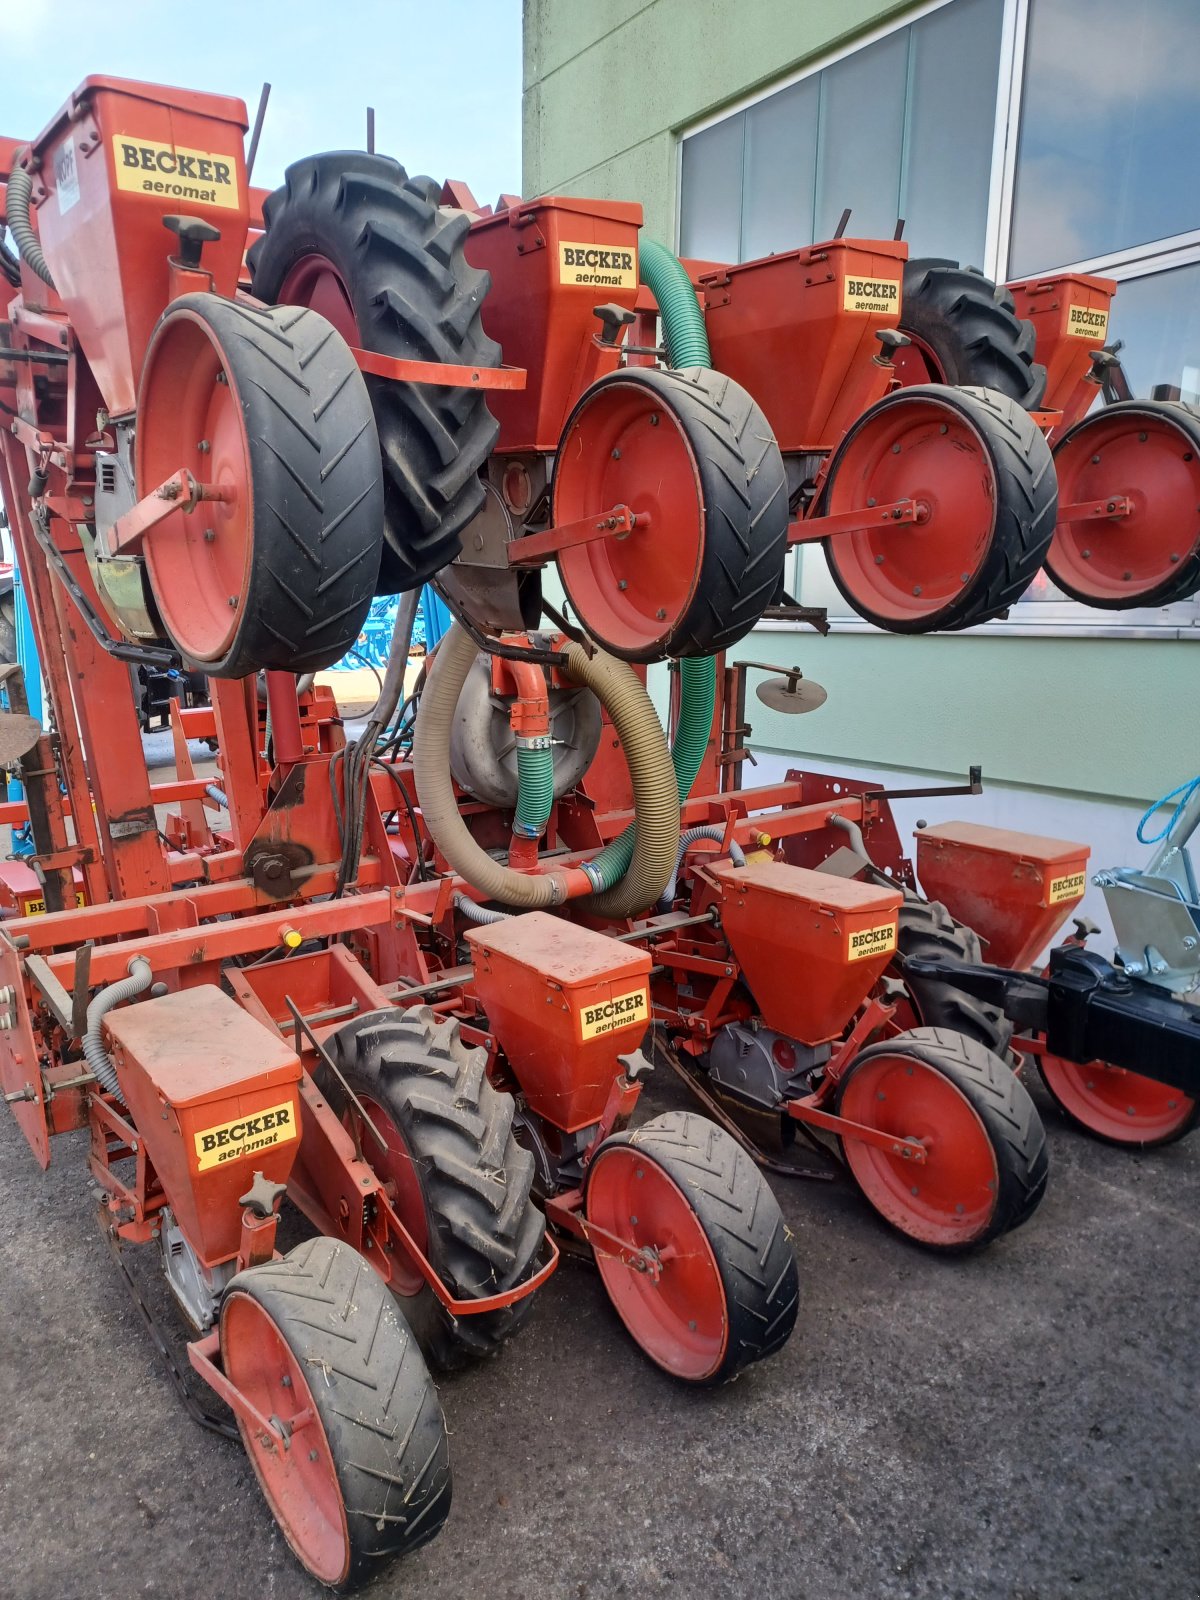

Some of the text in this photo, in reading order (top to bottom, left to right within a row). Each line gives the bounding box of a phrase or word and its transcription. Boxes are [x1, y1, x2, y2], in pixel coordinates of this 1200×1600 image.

[122, 144, 231, 185] BECKER
[142, 179, 216, 202] aeromat
[563, 247, 632, 271] BECKER
[575, 272, 622, 286] aeromat
[848, 280, 897, 299] BECKER
[855, 301, 889, 312] aeromat
[1070, 309, 1106, 327] BECKER
[1074, 327, 1099, 337] aeromat
[1052, 875, 1084, 893] BECKER
[852, 927, 893, 948] BECKER
[857, 943, 887, 956] aeromat
[585, 994, 643, 1025] BECKER
[595, 1013, 636, 1034] aeromat
[201, 1109, 290, 1152] BECKER
[218, 1132, 278, 1162] aeromat
